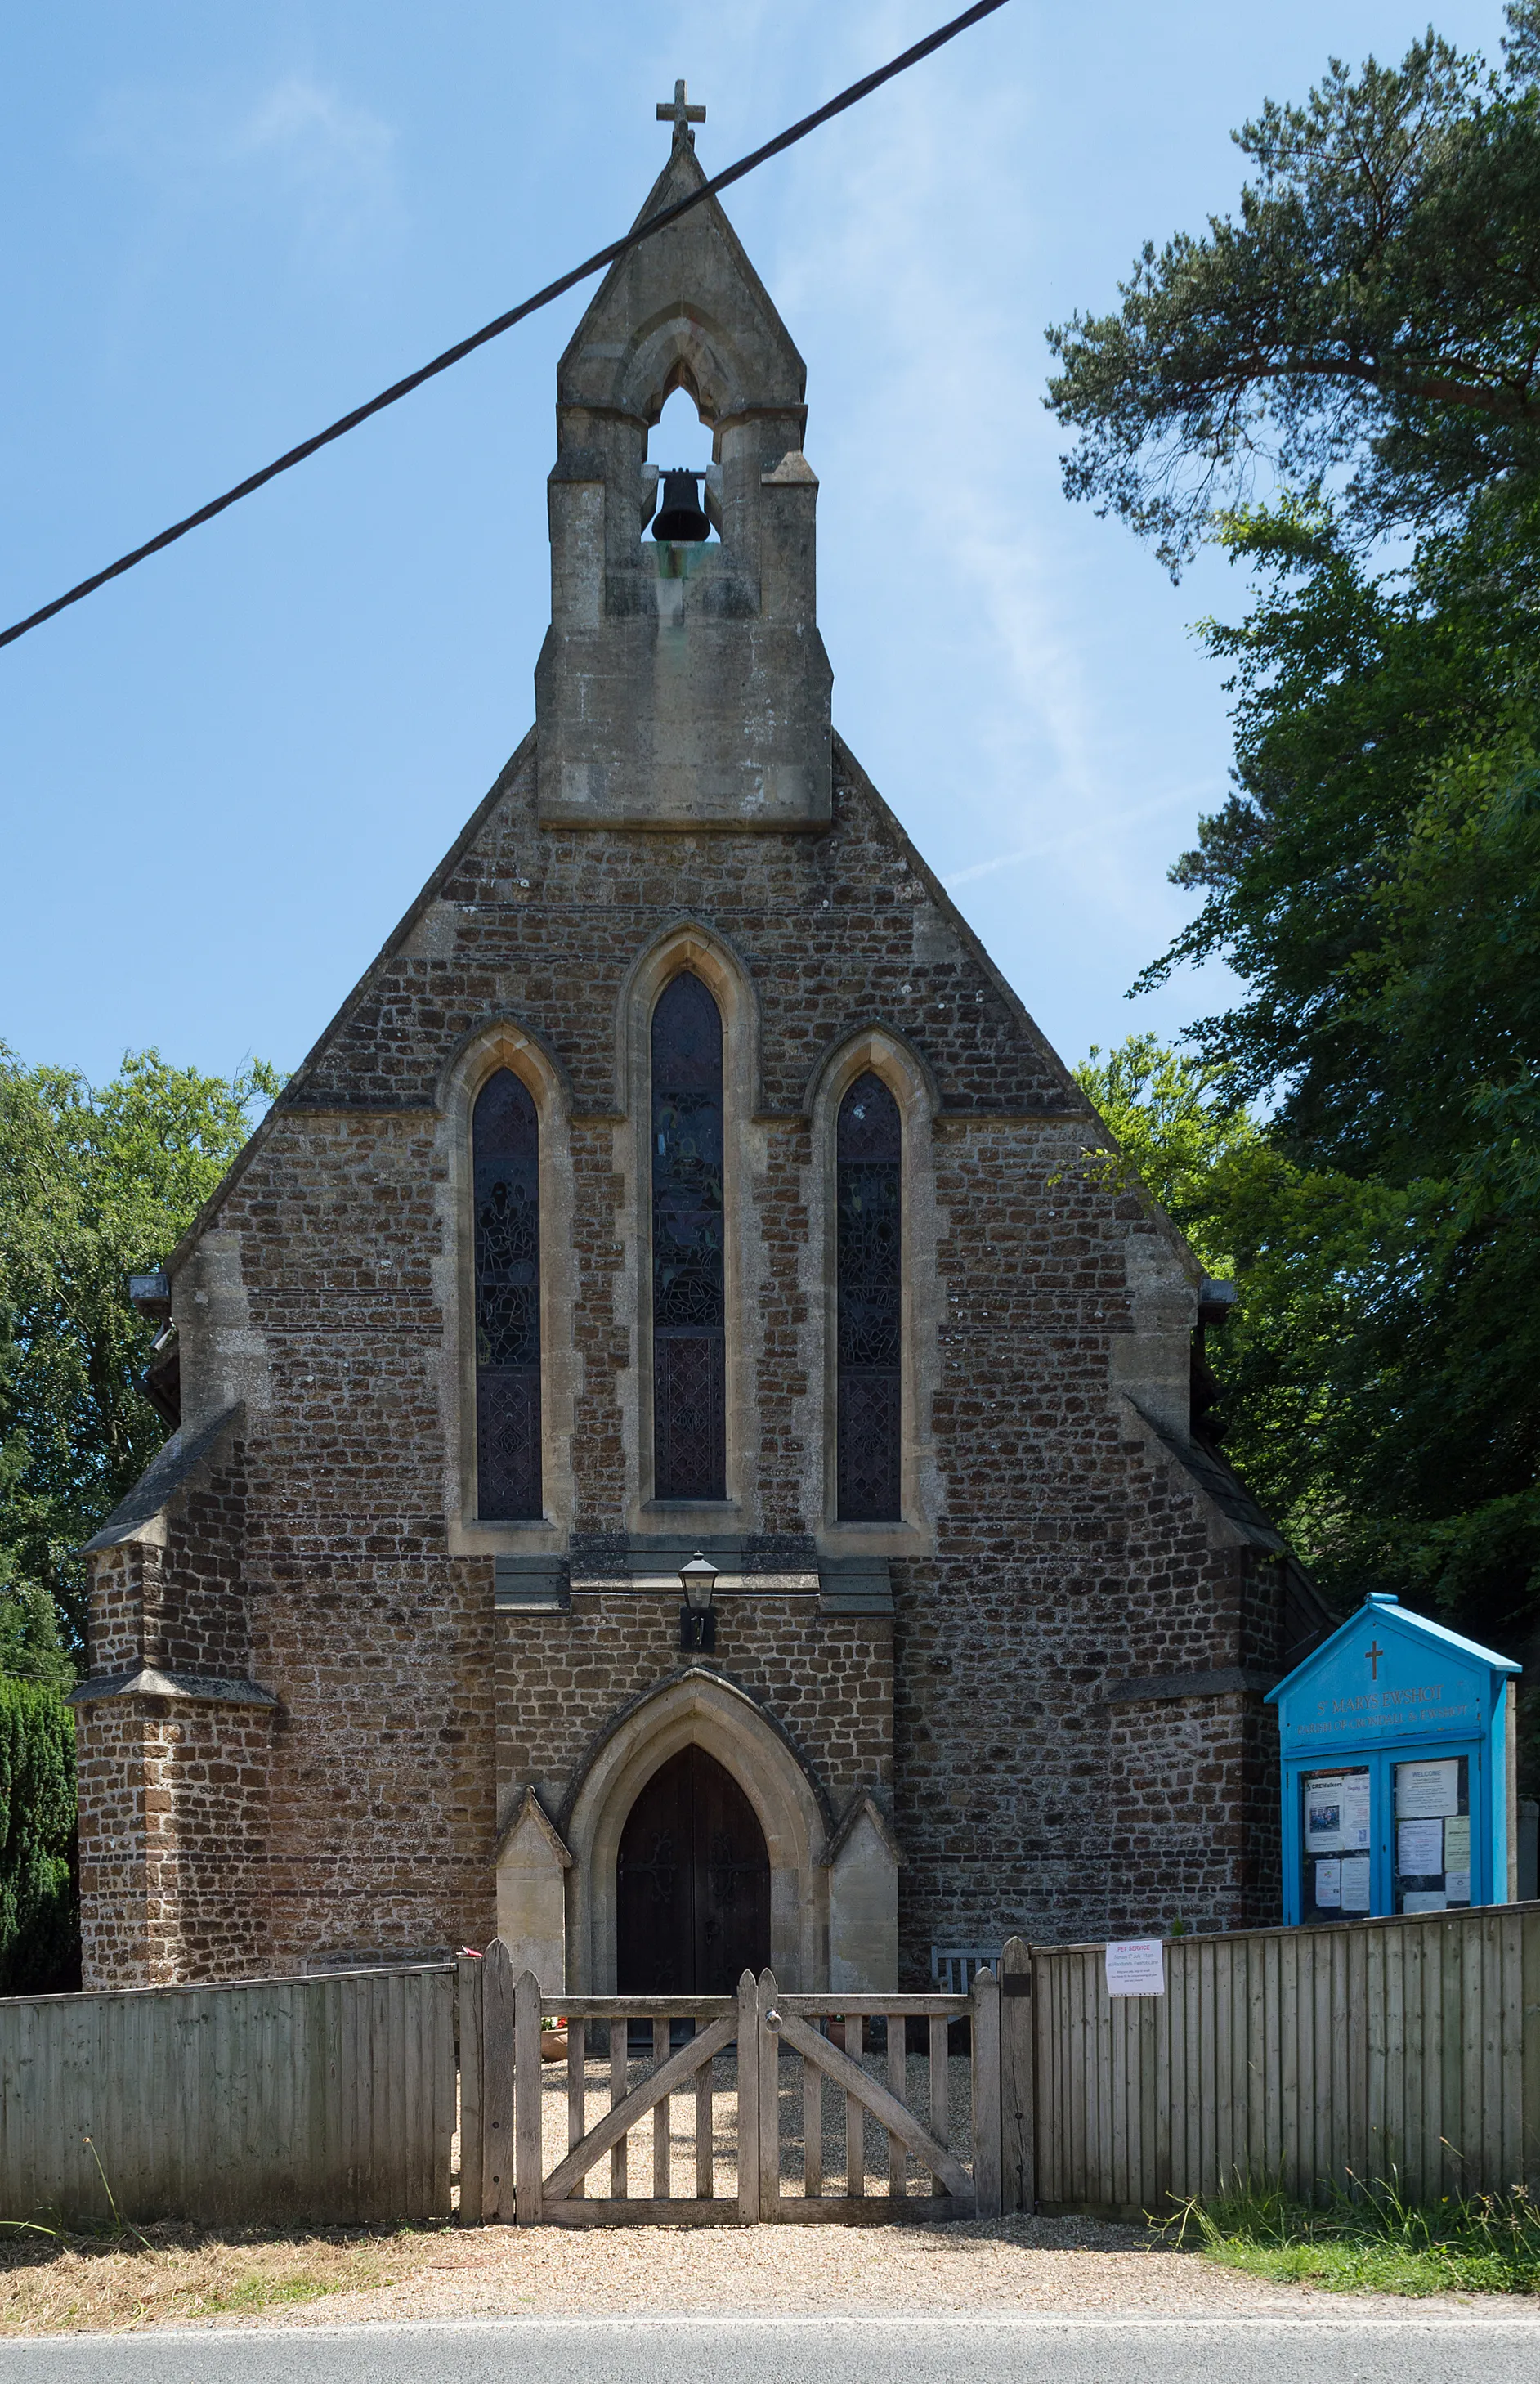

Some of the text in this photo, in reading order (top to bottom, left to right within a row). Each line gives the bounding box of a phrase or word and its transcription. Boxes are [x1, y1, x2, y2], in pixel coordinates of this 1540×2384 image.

[1332, 1693, 1379, 1714] MARYS
[1382, 1684, 1444, 1707] EWSHOT
[1297, 1705, 1467, 1736] PARISH OF CRONDALL & EWSHOT
[1412, 1769, 1442, 1777] WELCOME
